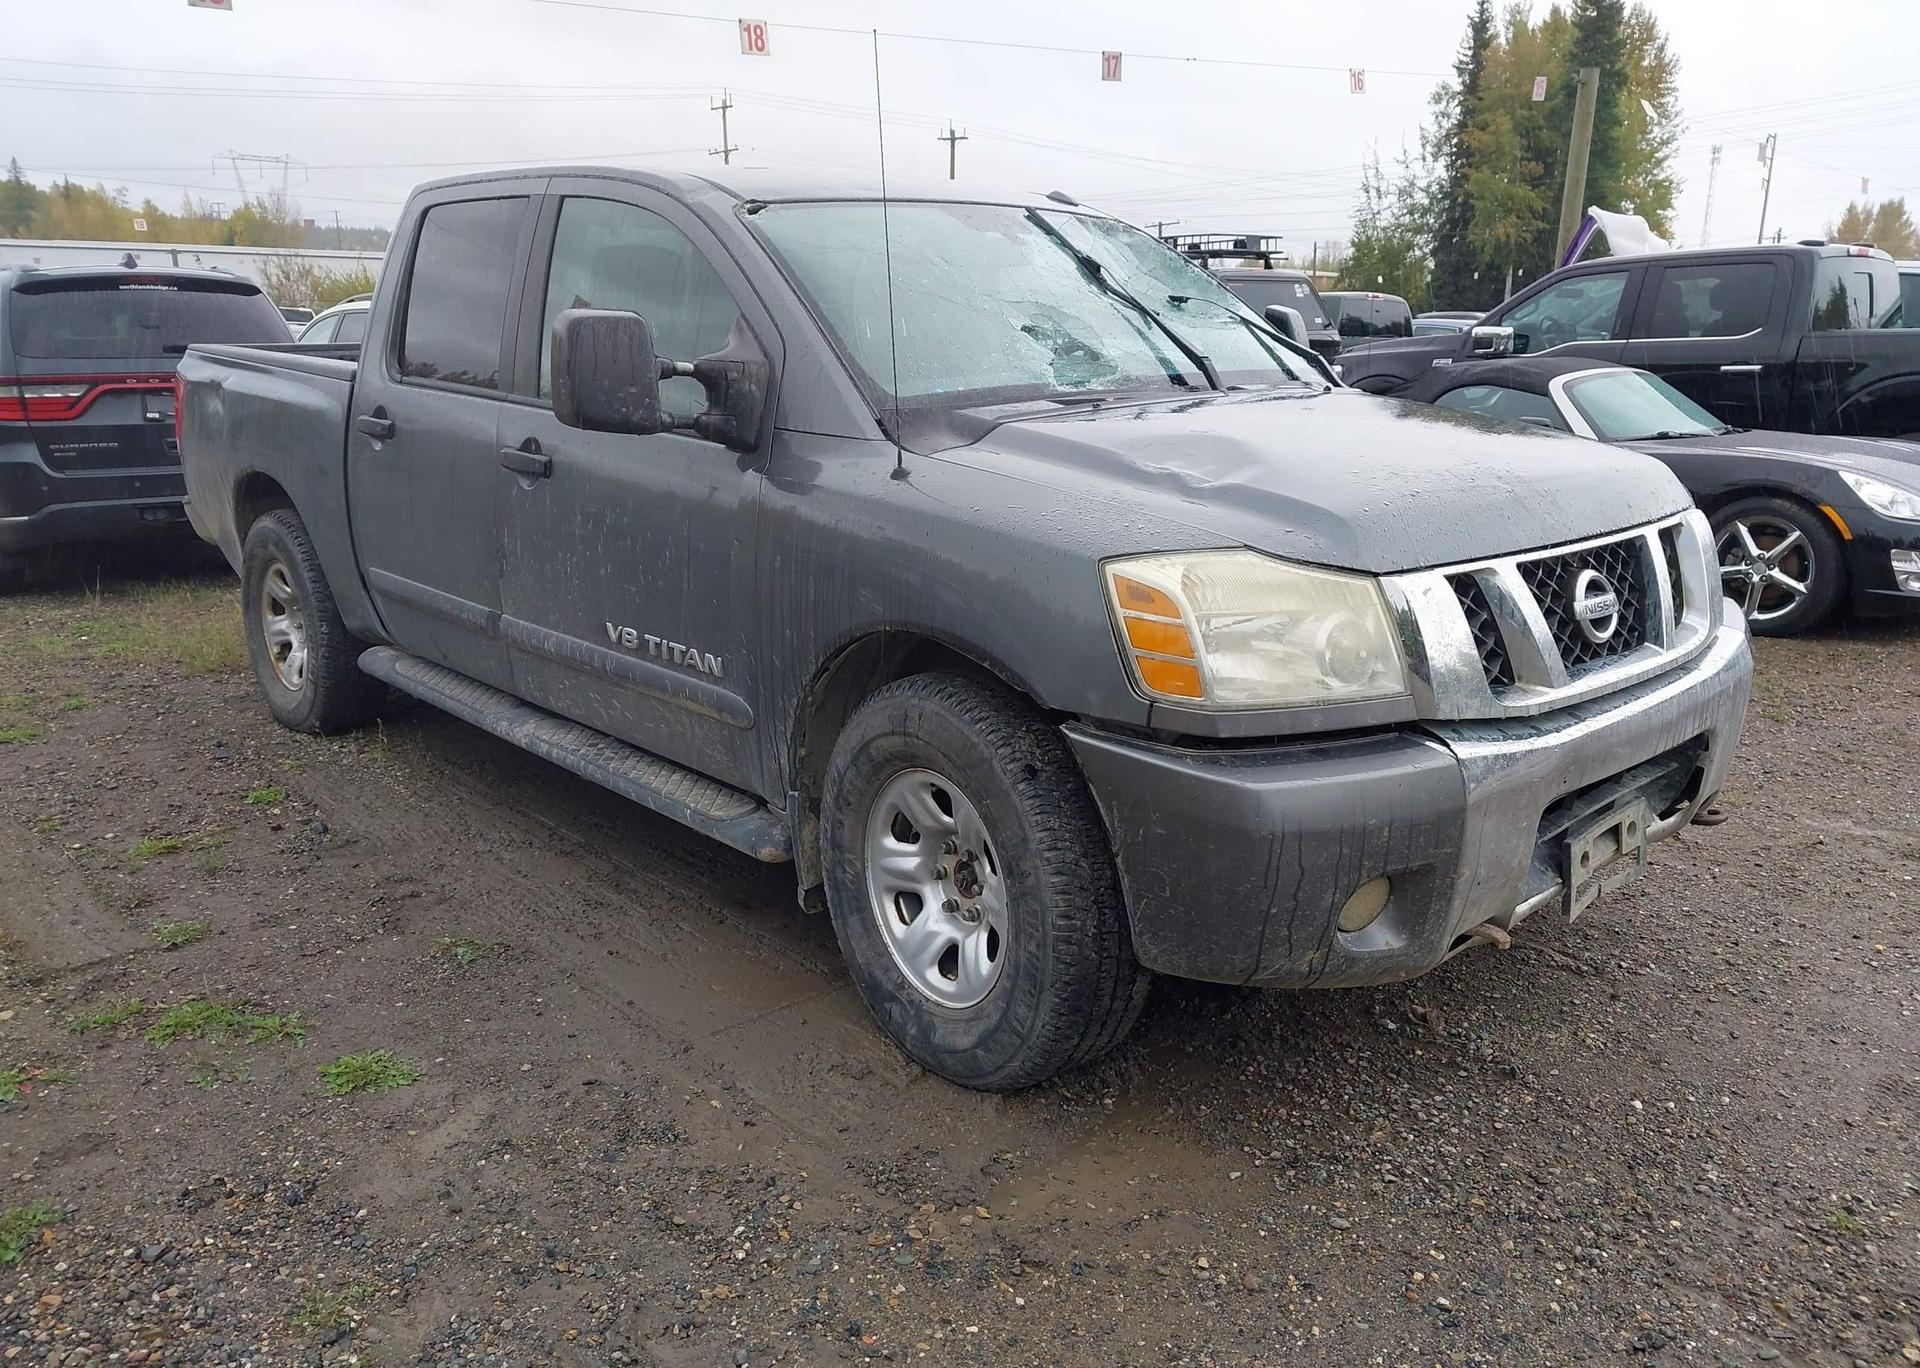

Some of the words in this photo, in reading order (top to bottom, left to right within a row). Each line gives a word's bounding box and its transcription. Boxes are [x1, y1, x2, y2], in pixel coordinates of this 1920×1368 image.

[743, 23, 765, 52] 18
[1105, 54, 1119, 78] 17
[1352, 71, 1363, 91] 16
[135, 220, 145, 229] 18
[605, 622, 638, 648] V8
[644, 634, 724, 678] TITAN
